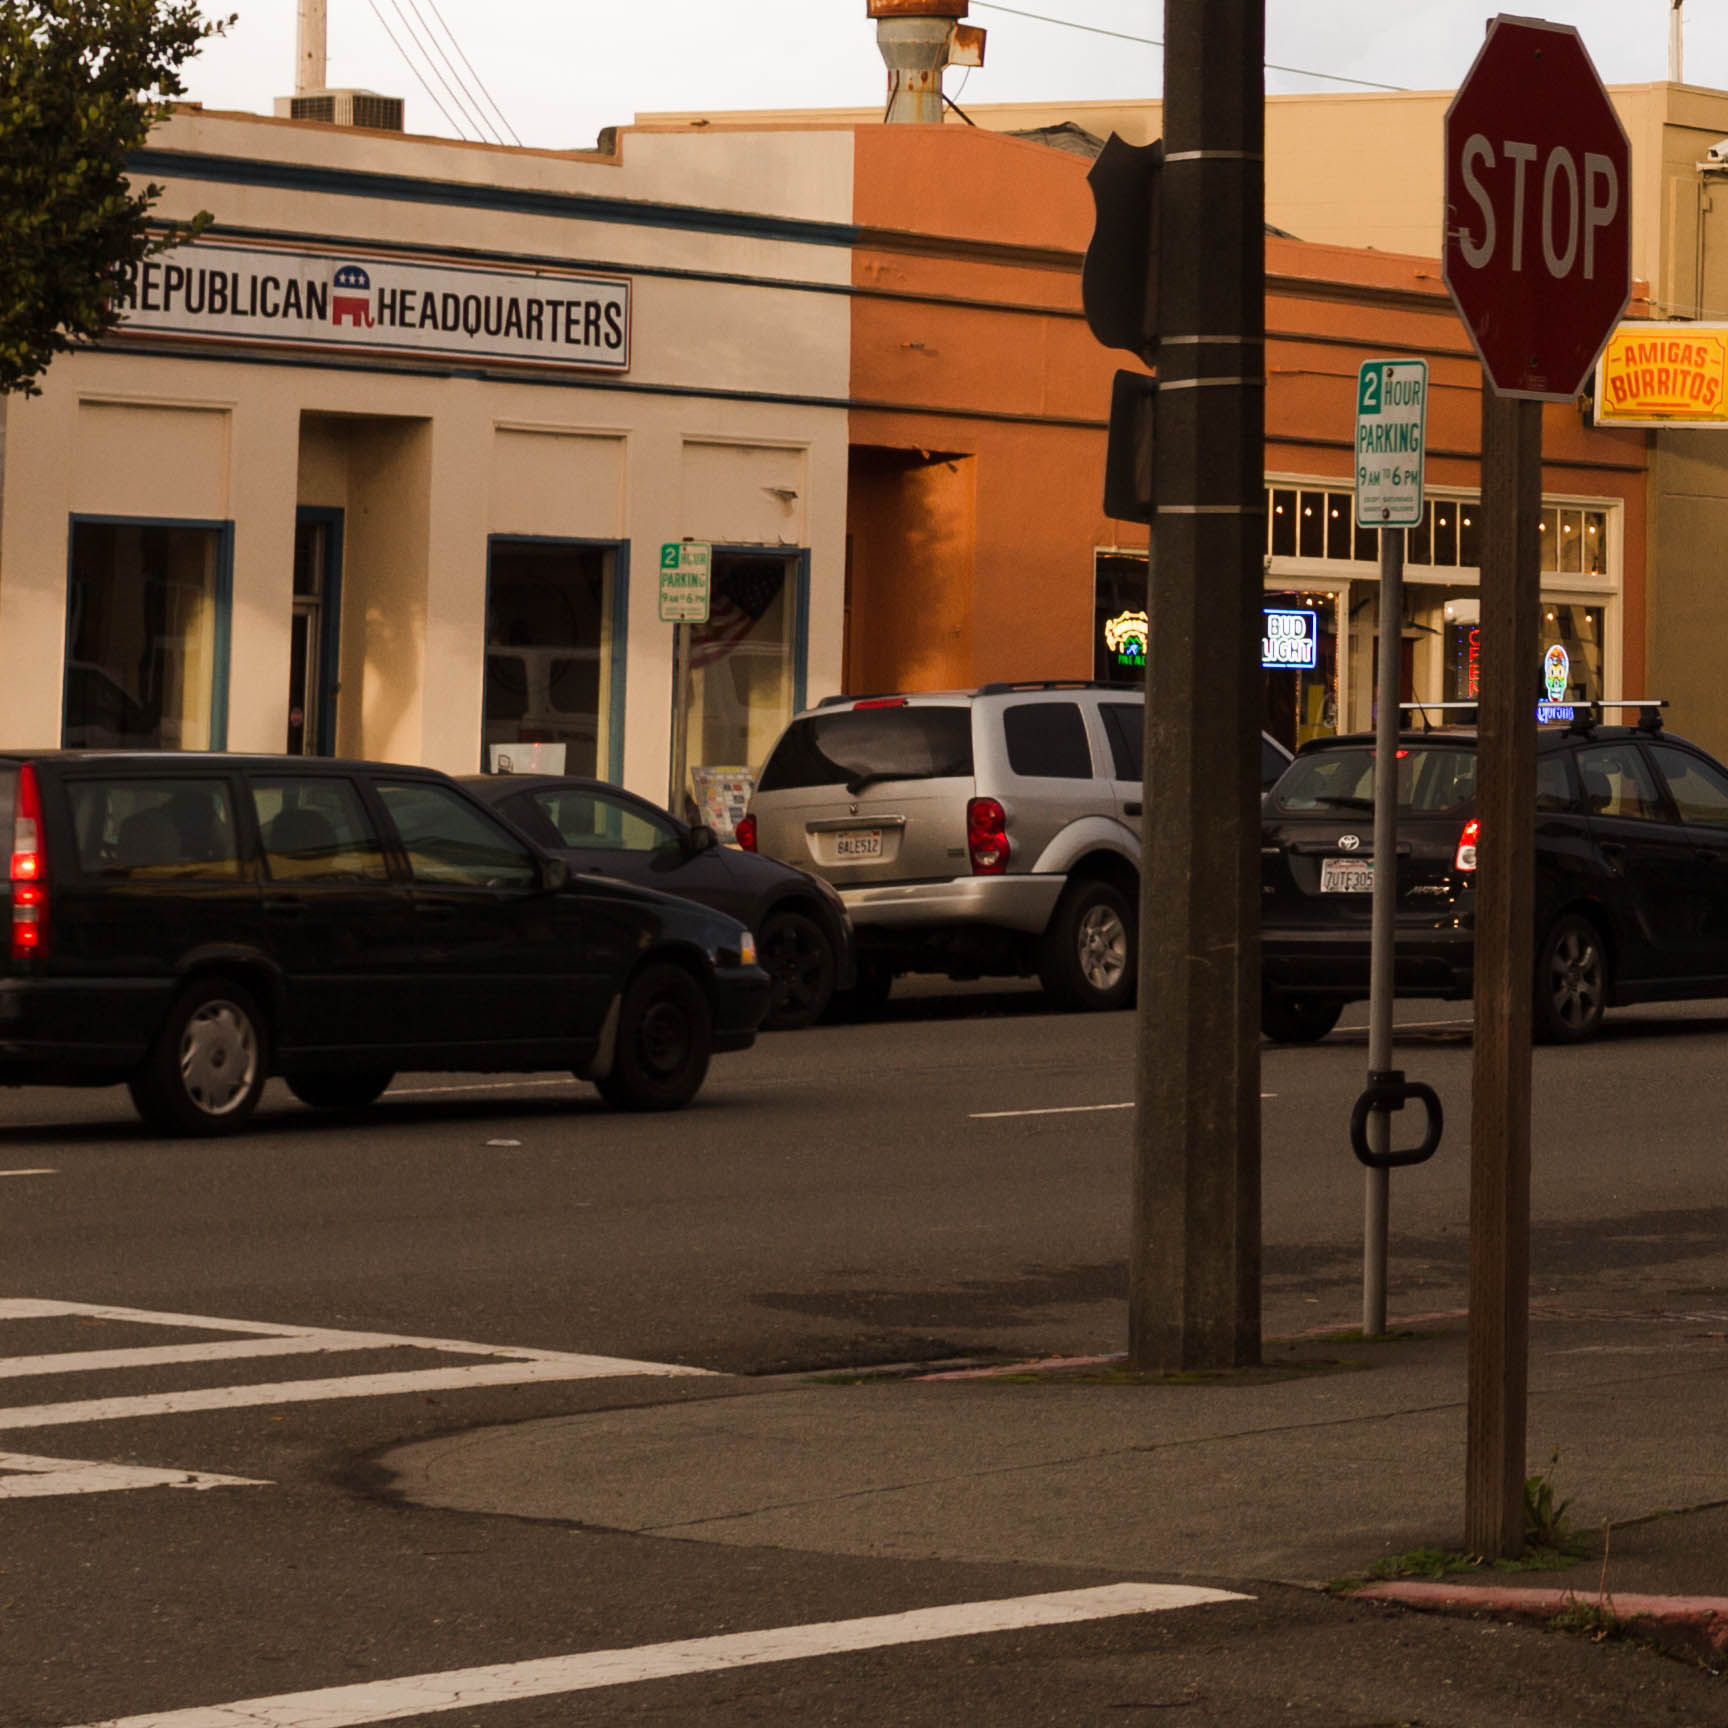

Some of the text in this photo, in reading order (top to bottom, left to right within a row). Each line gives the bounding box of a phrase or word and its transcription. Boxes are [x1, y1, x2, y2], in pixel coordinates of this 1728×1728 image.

[1459, 133, 1619, 280] STOP
[116, 260, 623, 350] REPUBLICAN HEADQUARTERS
[1624, 341, 1709, 370] AMIGAS
[1363, 371, 1421, 407] 2 HOUR
[1610, 367, 1722, 407] BURRITOS
[1359, 423, 1420, 454] PARKING
[665, 548, 677, 565] 2
[1267, 614, 1307, 639] BUD
